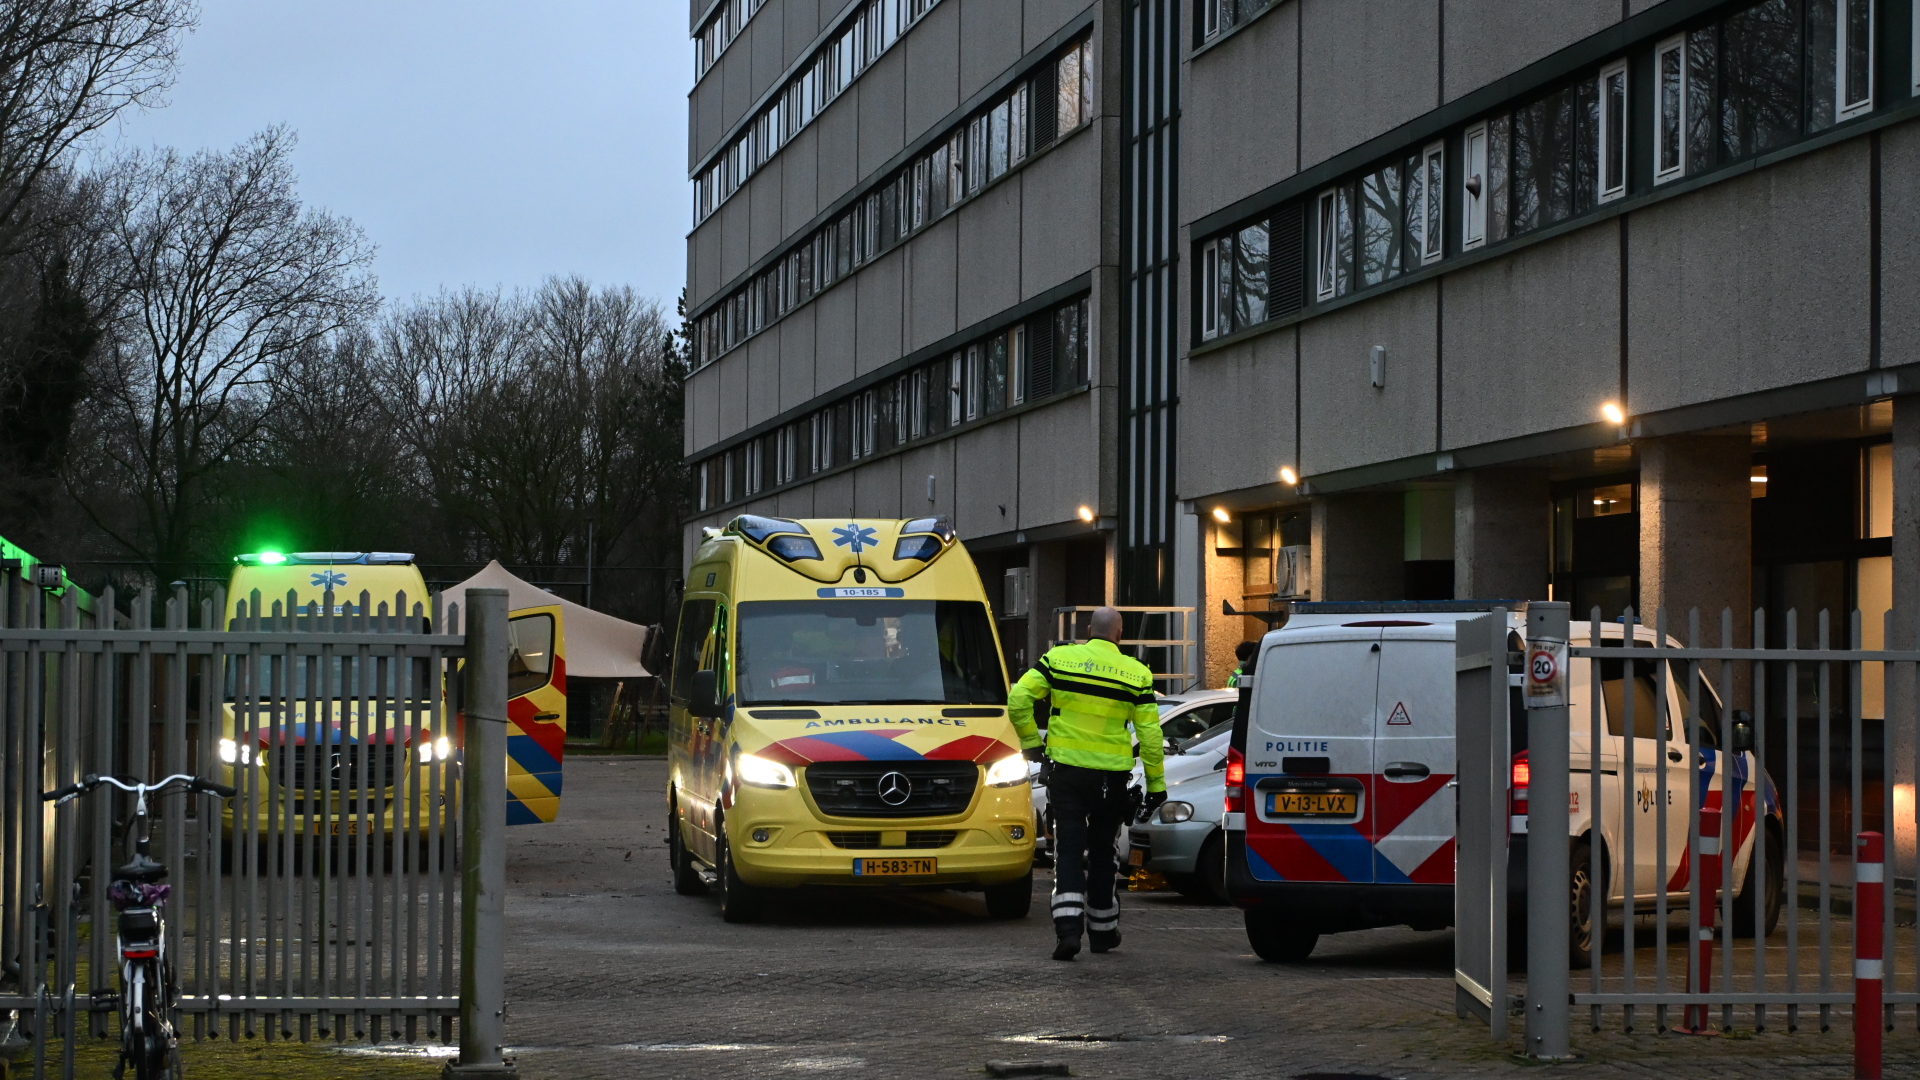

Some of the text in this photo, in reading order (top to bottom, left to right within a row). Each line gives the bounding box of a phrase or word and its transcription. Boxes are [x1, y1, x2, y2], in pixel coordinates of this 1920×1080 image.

[1534, 660, 1551, 674] 20
[805, 717, 966, 729] AMBULANCE
[1266, 742, 1328, 751] POLITIE
[1282, 796, 1346, 811] V-13-LVX
[866, 860, 931, 874] H-583-TN
